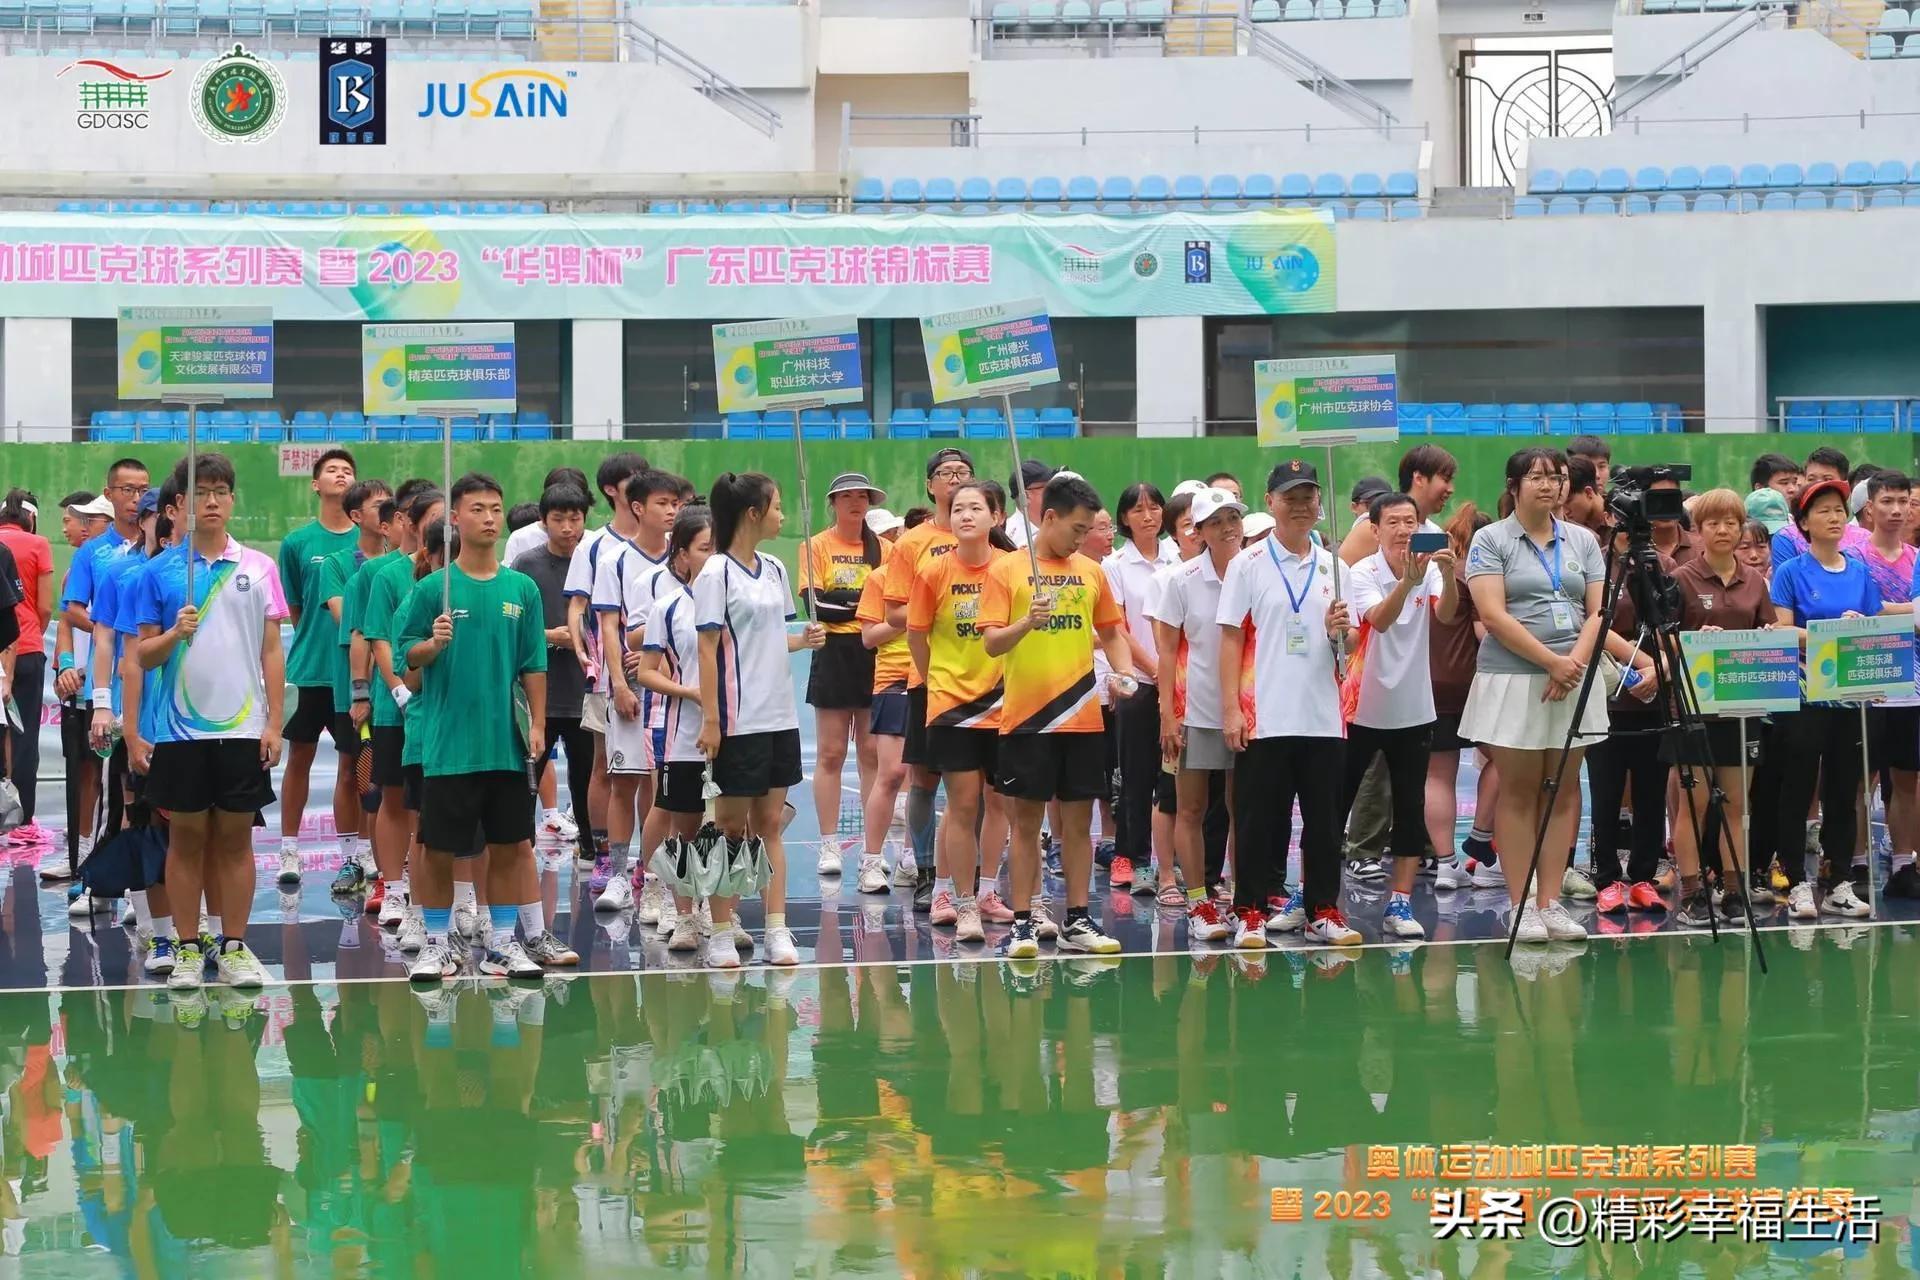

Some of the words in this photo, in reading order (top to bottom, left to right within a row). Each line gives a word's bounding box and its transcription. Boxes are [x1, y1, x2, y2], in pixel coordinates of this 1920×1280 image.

[320, 249, 356, 285] 暨
[368, 251, 459, 283] 2023
[666, 247, 991, 285] 广东匹克球锦标赛
[987, 340, 1030, 359] 广州德兴
[175, 363, 262, 375] 文化发展有限公司
[782, 357, 831, 373] 广州科技
[978, 352, 1043, 375] 匹克球俱乐部
[407, 368, 511, 382] 精英匹克球俱乐部
[770, 371, 844, 389] 职业技术大学
[1299, 399, 1394, 416] 广州市匹克球协会
[832, 555, 871, 564] PICKLEB
[1028, 575, 1085, 586] PKLEBALL
[1717, 670, 1798, 684] 东莞市匹克球协会
[1847, 667, 1902, 681] 匹克球俱乐部
